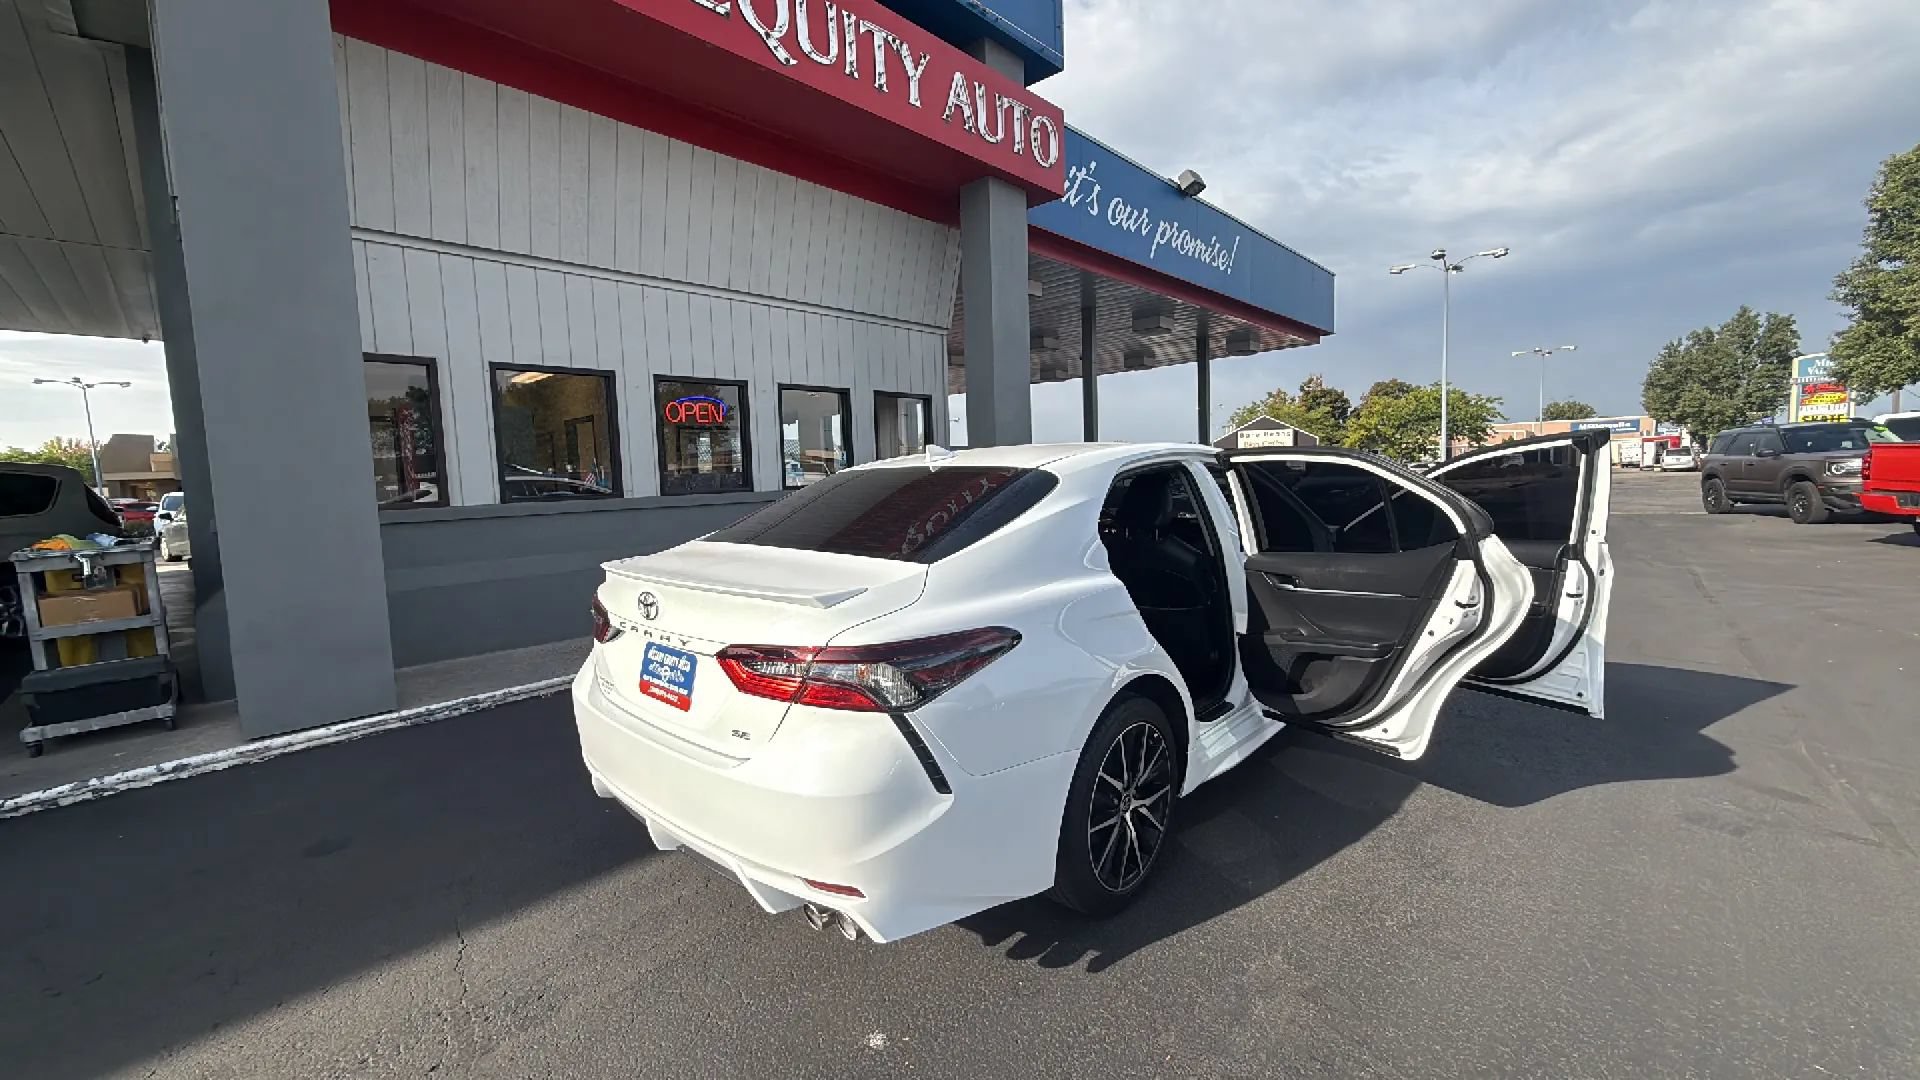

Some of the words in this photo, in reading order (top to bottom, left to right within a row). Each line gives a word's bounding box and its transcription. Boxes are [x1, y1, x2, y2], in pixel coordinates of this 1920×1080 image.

[689, 0, 931, 108] QUITY
[942, 71, 1059, 168] AUTO
[1062, 160, 1101, 216] it's
[1107, 197, 1153, 236] our
[1150, 219, 1241, 275] promise!
[665, 401, 723, 423] OPEN
[619, 621, 691, 646] CAMRY
[731, 729, 751, 741] SE
